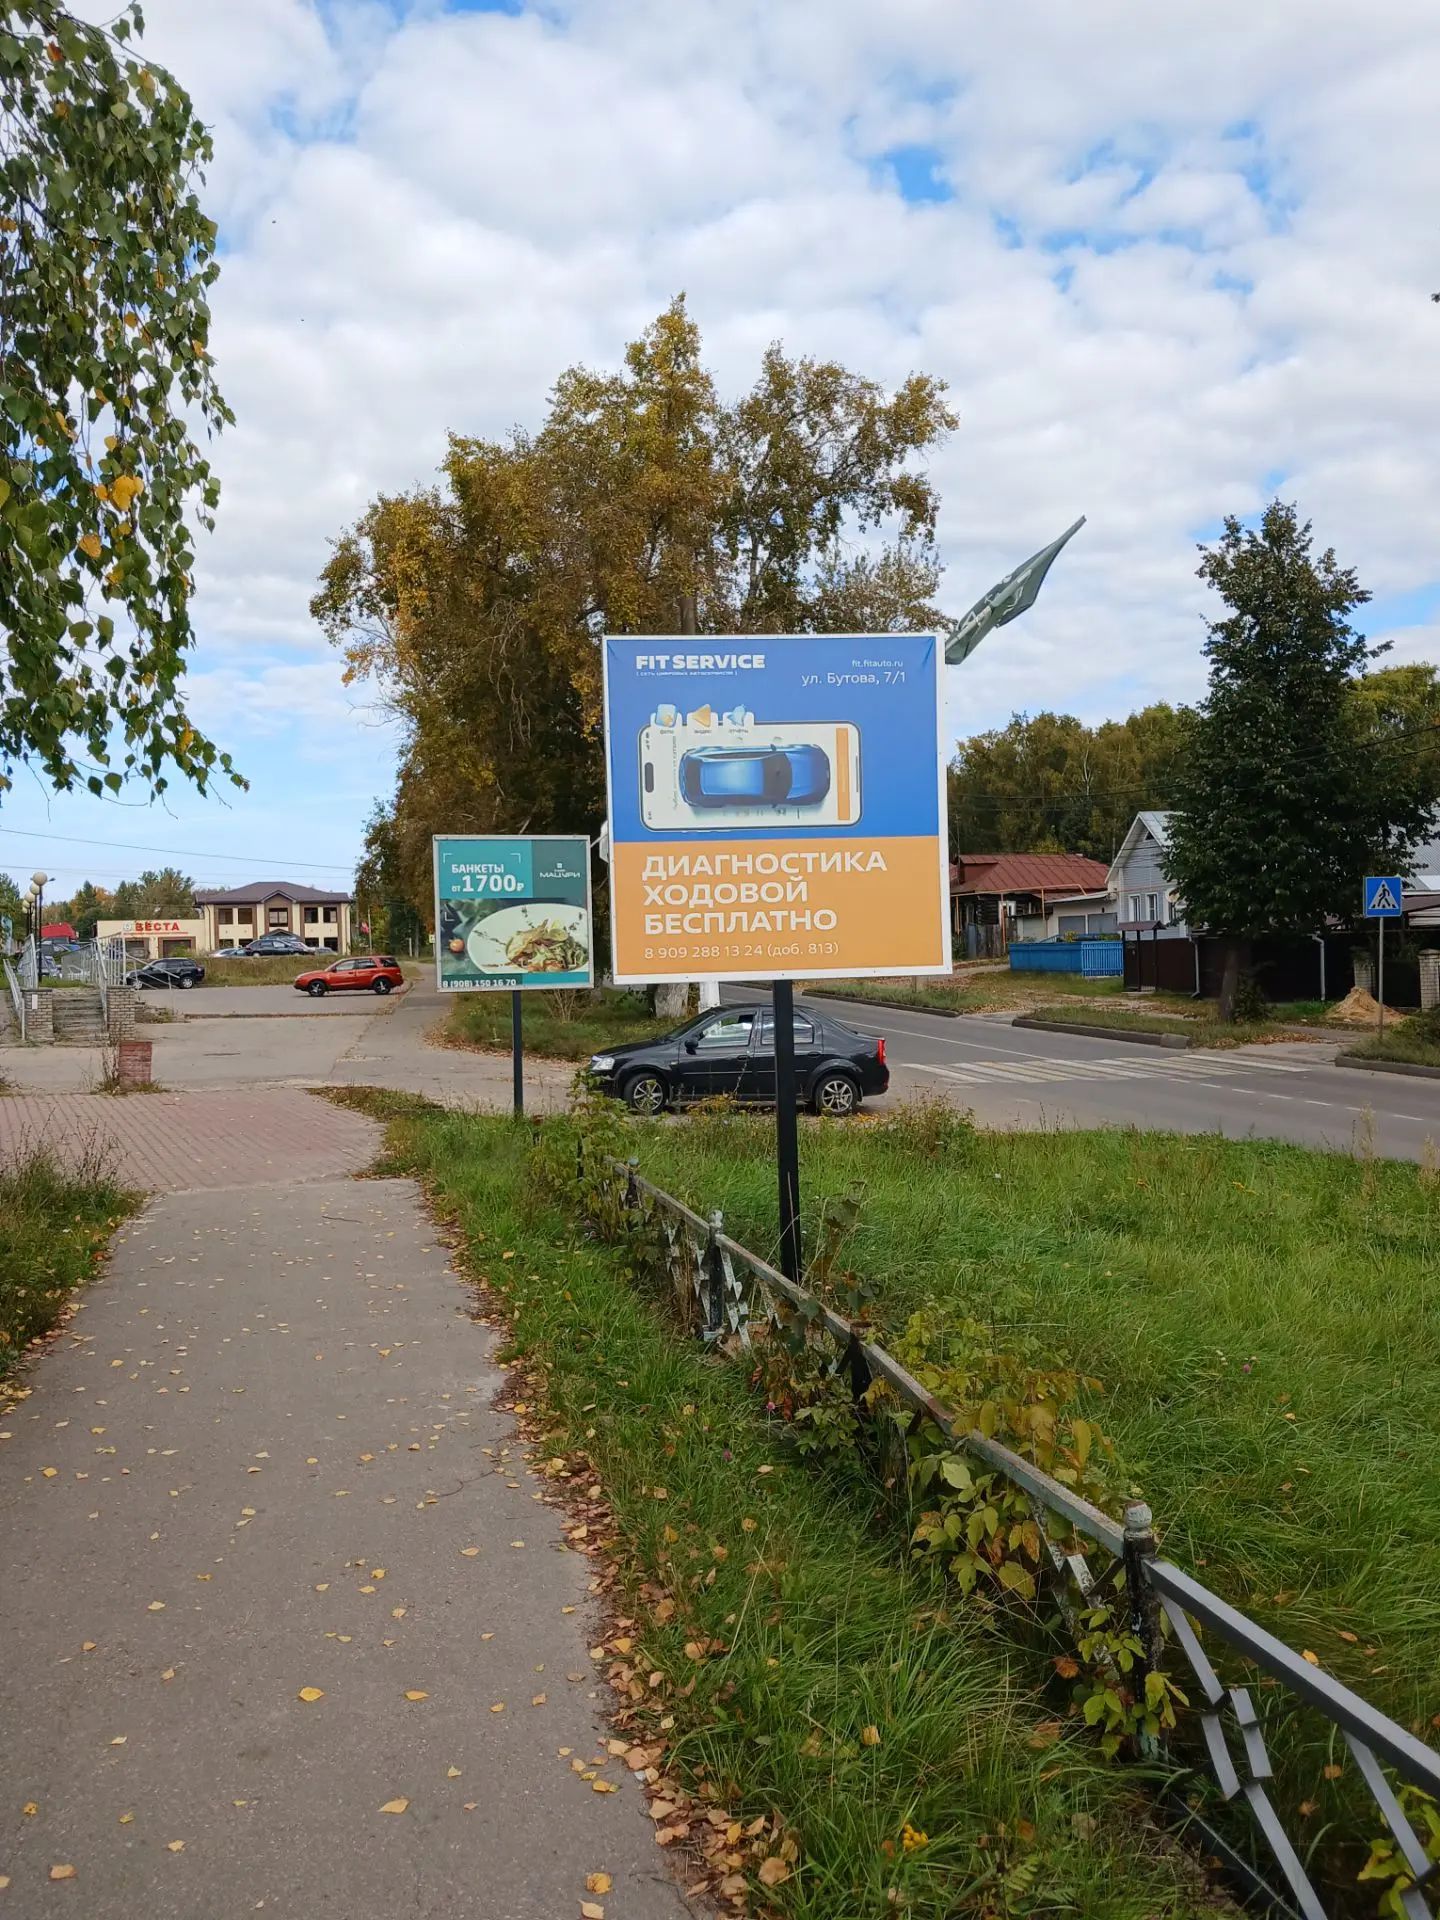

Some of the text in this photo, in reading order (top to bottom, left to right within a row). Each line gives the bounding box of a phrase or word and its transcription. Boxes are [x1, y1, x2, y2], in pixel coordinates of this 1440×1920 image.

[636, 654, 766, 670] FIT SERVICE
[852, 659, 903, 667] fit.fitauto.ru
[802, 671, 905, 687] ул. Бутова, 7/1
[451, 863, 504, 873] БАНКЕТЫ
[642, 851, 888, 881] ДИАГНОСТИКА
[643, 875, 808, 908] ХОДОВОЙ
[135, 922, 180, 931] ВЕСТА
[644, 909, 837, 935] БЕСПЛАТНО
[644, 942, 839, 959] 8 909 288 13 24 (доб. 813)
[506, 978, 517, 986] 70
